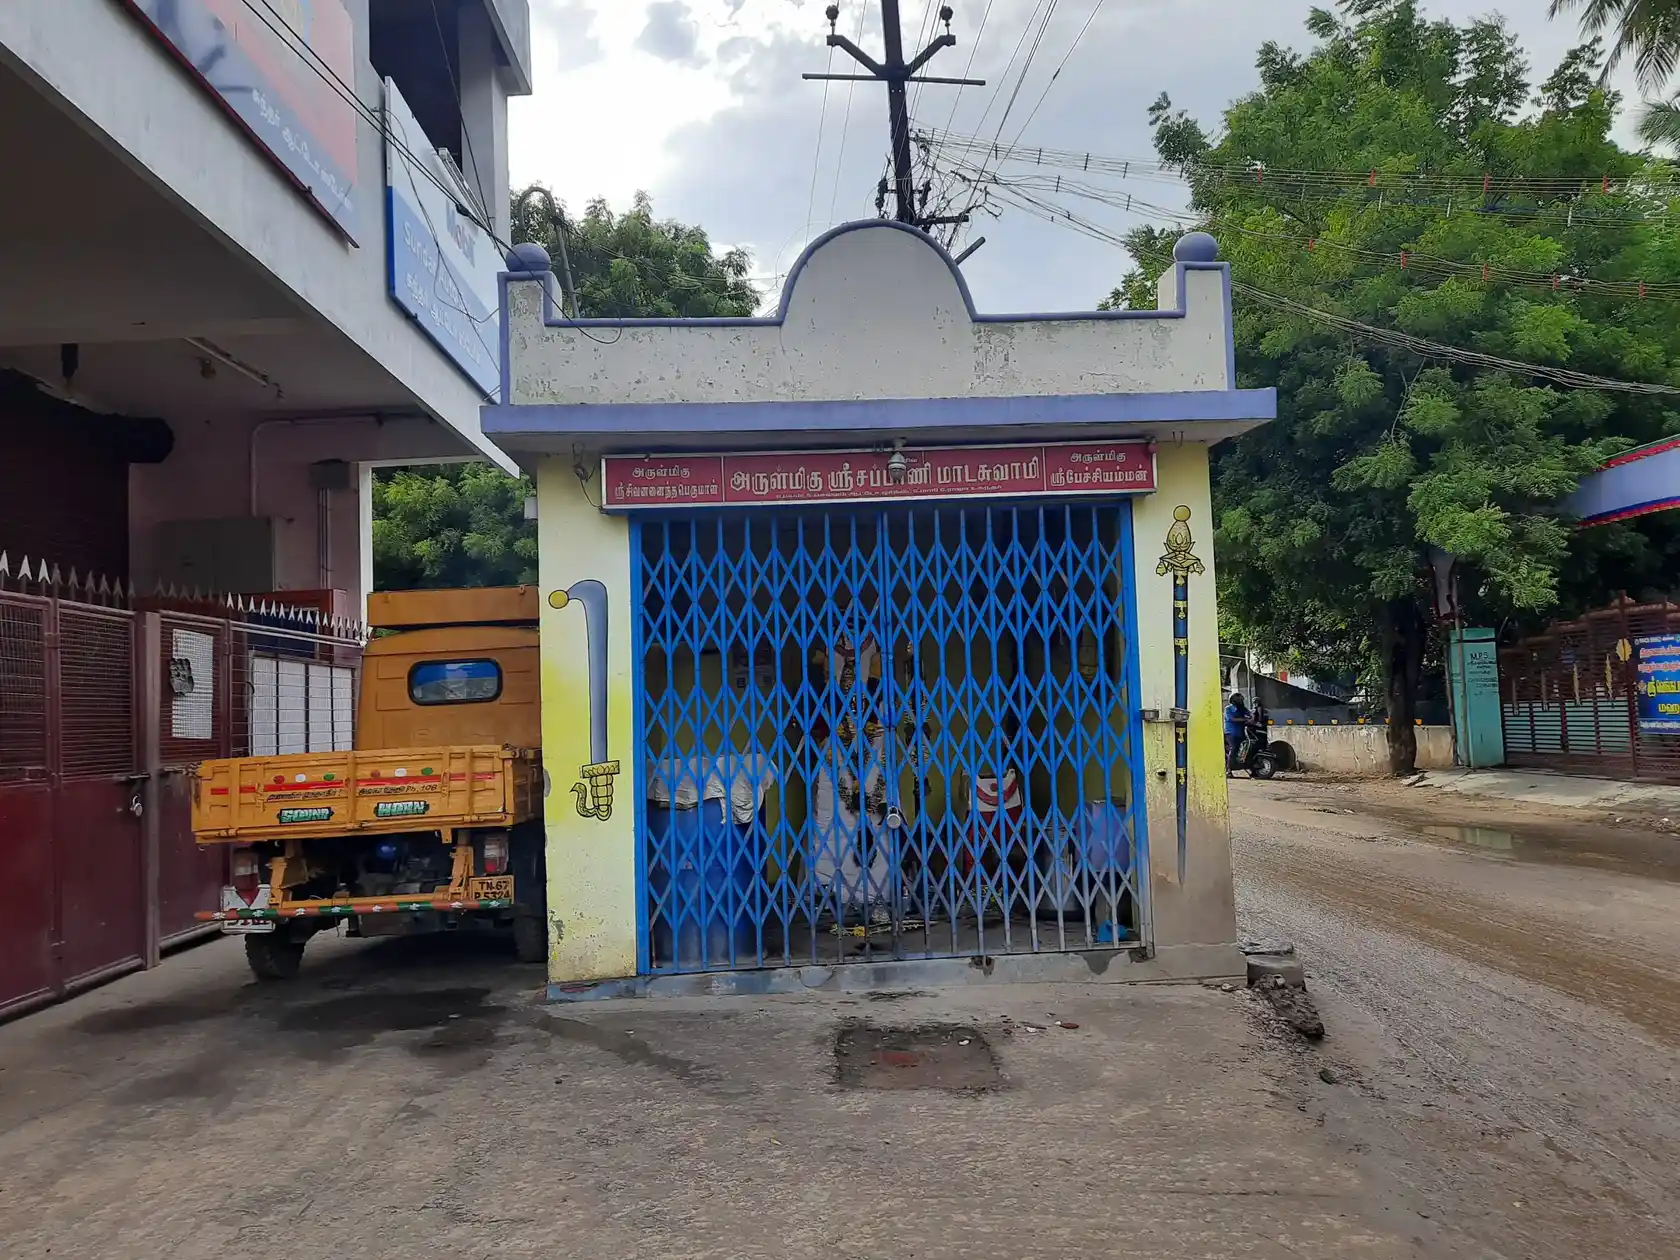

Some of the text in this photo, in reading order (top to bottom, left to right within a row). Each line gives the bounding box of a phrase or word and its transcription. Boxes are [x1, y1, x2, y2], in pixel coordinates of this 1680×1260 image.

[1070, 449, 1126, 464] அருள்மிகு
[632, 464, 690, 480] அருள்மிகு
[730, 464, 823, 495] அருள்மிகு
[937, 455, 1040, 484] மாடசுவாமி
[377, 801, 426, 817] HORN
